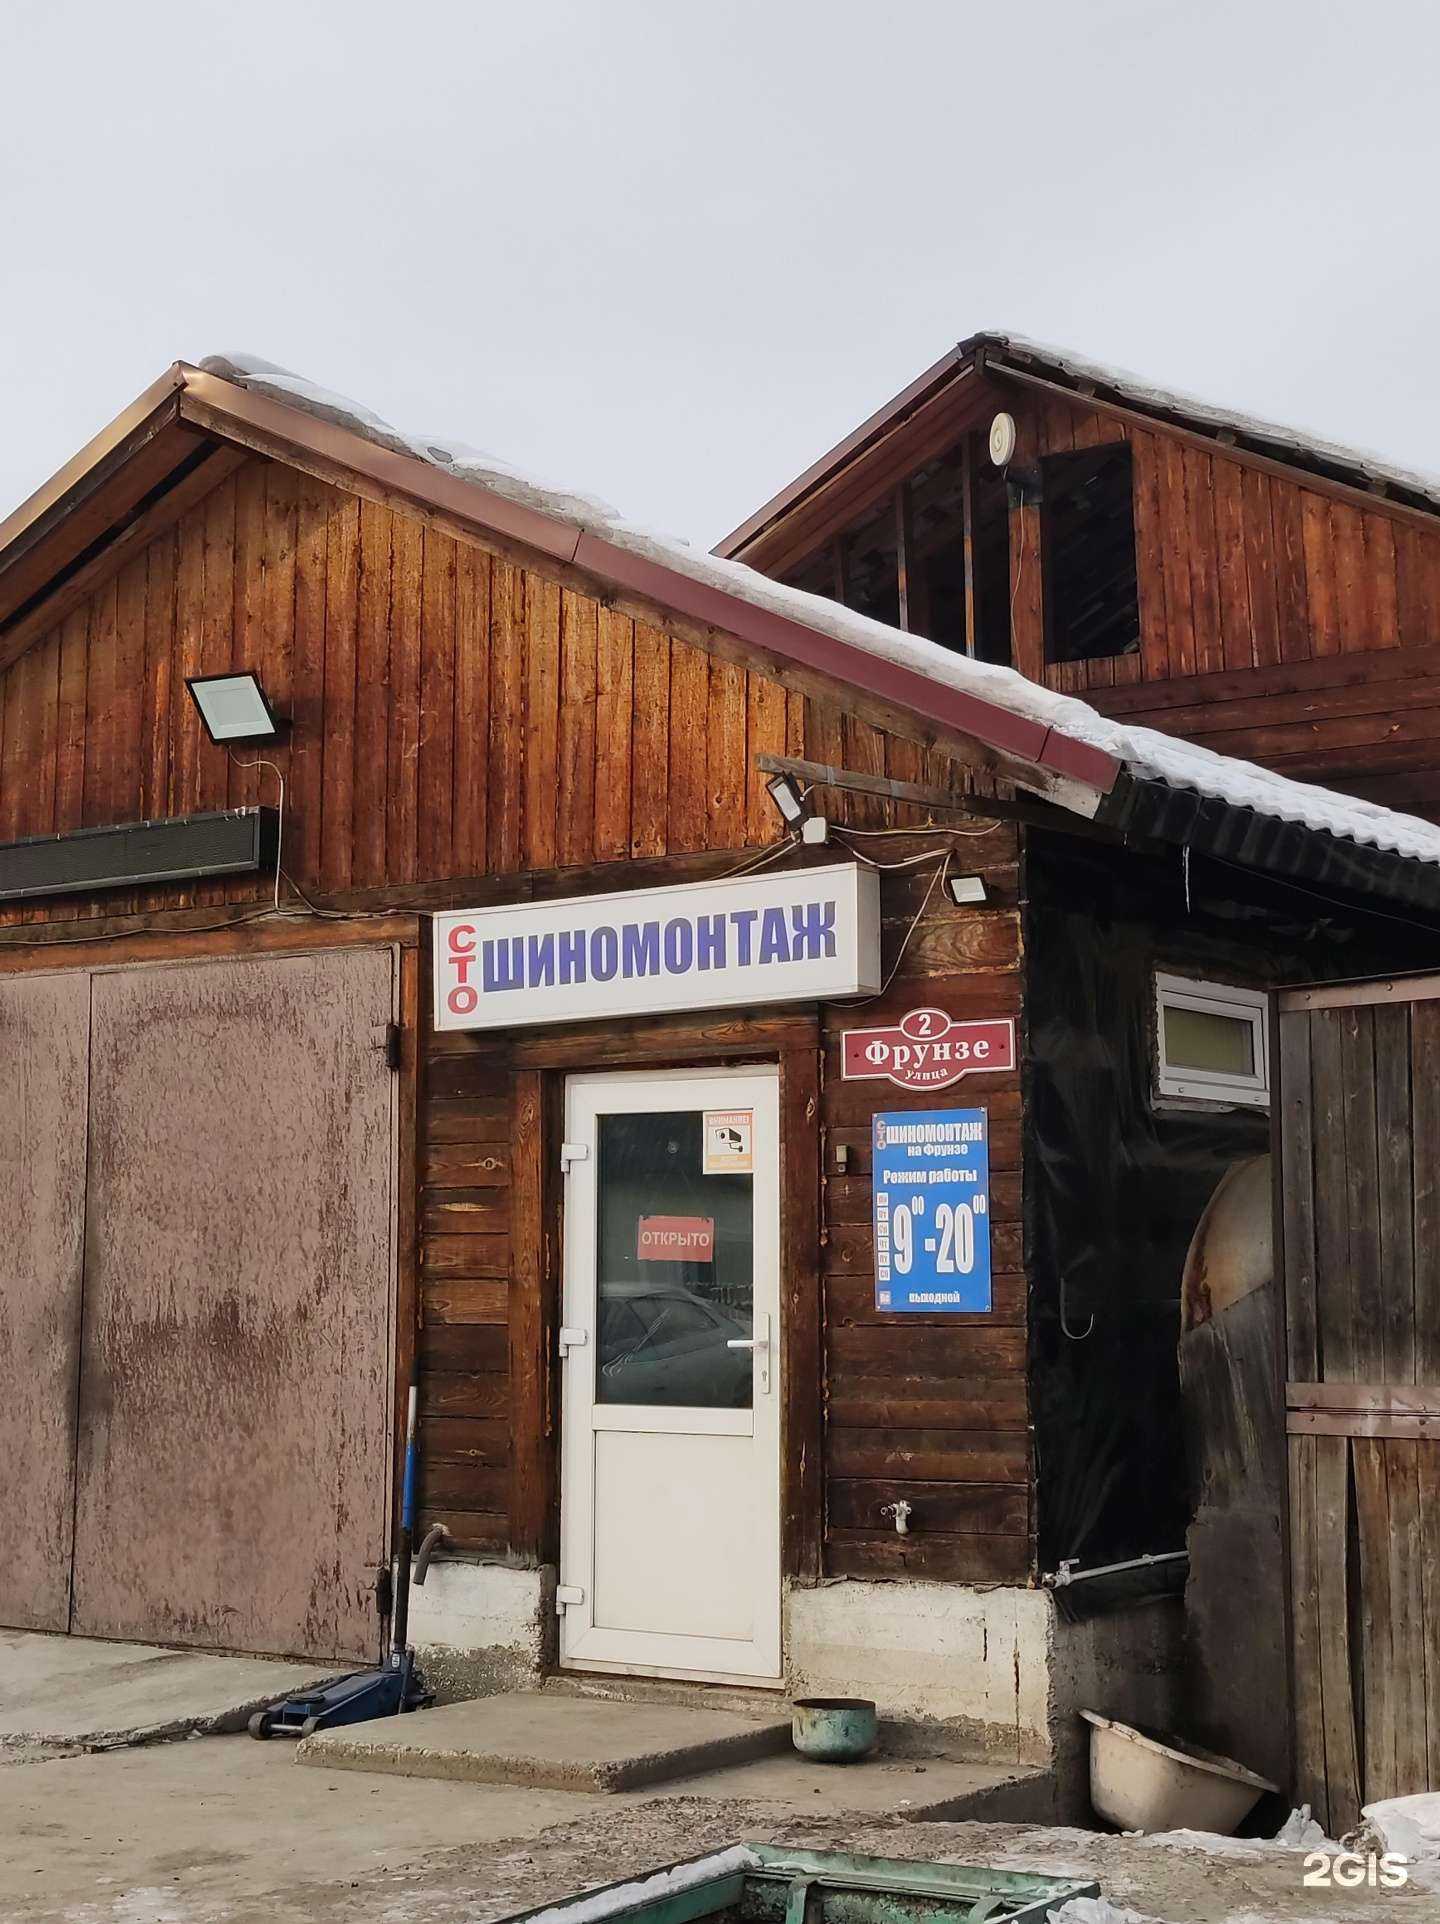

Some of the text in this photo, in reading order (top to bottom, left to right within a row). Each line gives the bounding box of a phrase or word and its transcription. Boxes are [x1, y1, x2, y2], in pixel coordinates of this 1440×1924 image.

[482, 900, 838, 993] ШИНОМОНТАЖ
[447, 924, 479, 1015] СТО
[918, 1013, 932, 1035] 2
[865, 1040, 990, 1070] Фрунзе
[905, 1067, 949, 1081] улица
[886, 1122, 983, 1144] ШИНОМОНТАЖ
[907, 1143, 969, 1158] на Фрунзе
[883, 1168, 978, 1184] Режим работы
[641, 1231, 710, 1247] ОТКРЫТО
